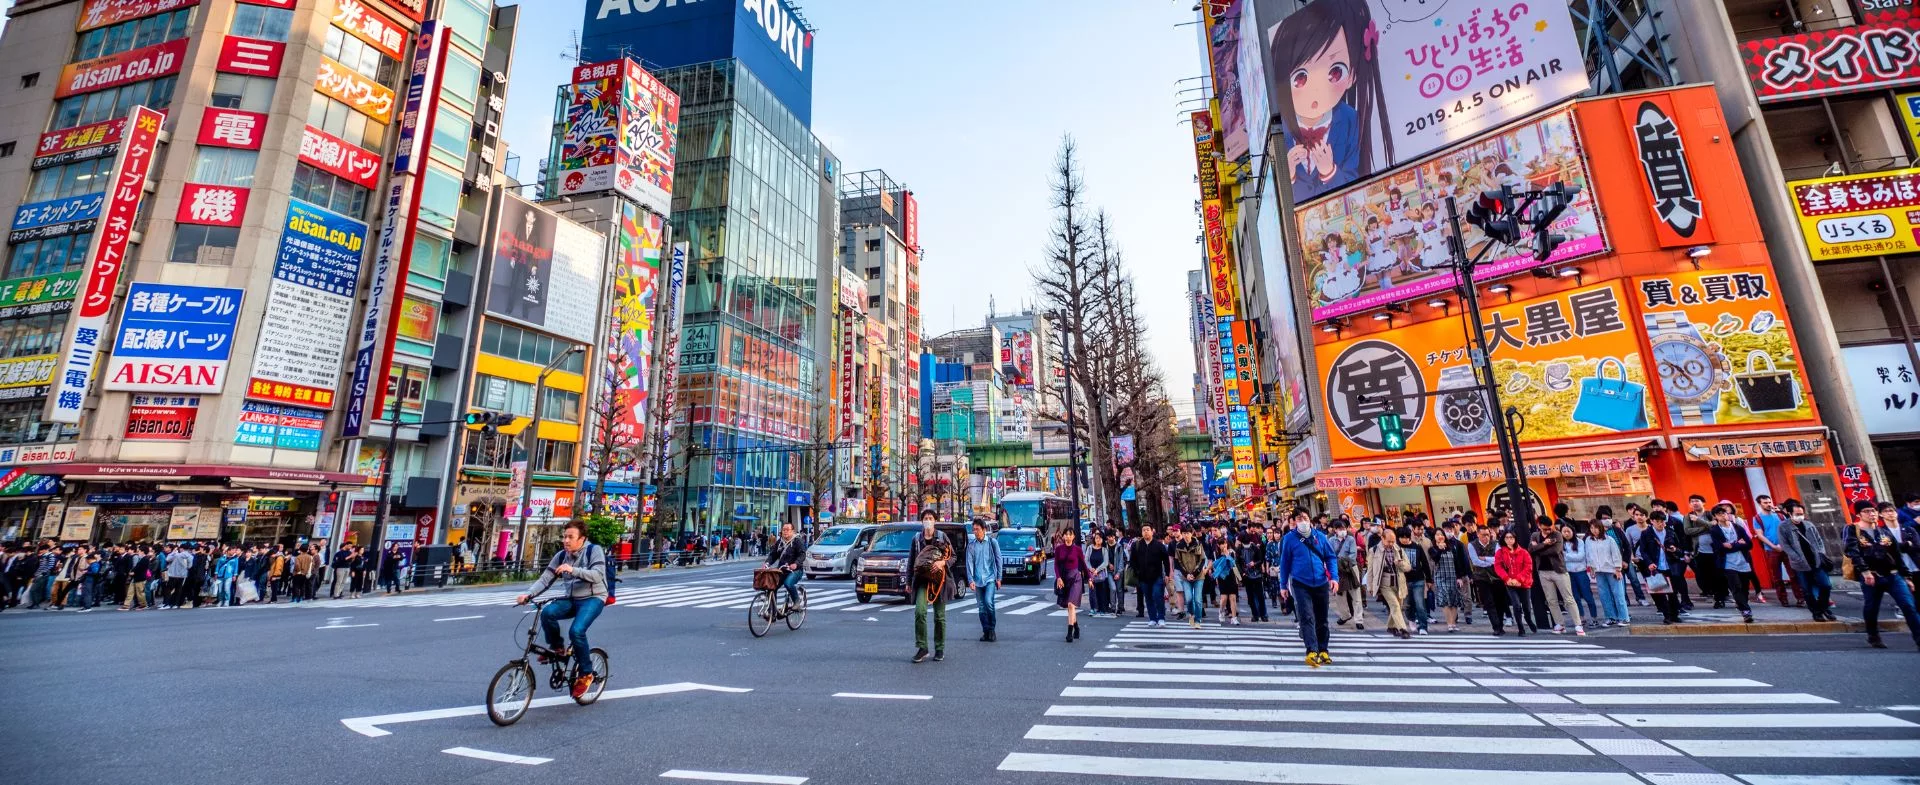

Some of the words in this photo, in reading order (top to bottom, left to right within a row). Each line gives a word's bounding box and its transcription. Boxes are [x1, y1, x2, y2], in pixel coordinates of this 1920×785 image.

[332, 0, 403, 54] 光通信
[743, 0, 803, 72] AOKI
[1405, 3, 1529, 68] ひとりぼっちの
[71, 52, 173, 90] aisan.co.jp
[579, 64, 619, 81] 免税店
[1764, 29, 1920, 89] メイド
[315, 63, 394, 115] ネットワーク
[1405, 91, 1484, 135] 2019.4.5
[1489, 75, 1520, 98] ON
[1526, 58, 1563, 85] AIR
[41, 134, 61, 151] 3F
[299, 130, 378, 179] 配線パーツ
[17, 210, 39, 227] 2F
[38, 195, 103, 226] ネットワーク
[289, 215, 362, 253] aisan.co.jp
[1823, 220, 1888, 239] りらくる
[363, 185, 402, 343] 各種ケーブル・ネットワーク機器
[1820, 241, 1907, 256] 秋葉原中央通り店
[672, 247, 684, 288] AKKY
[131, 287, 237, 320] 各種ケーブル
[1203, 296, 1214, 327] AKKY
[1481, 288, 1624, 357] 大黒屋
[121, 327, 229, 355] 配線パーツ
[57, 327, 98, 411] 愛三電機
[111, 362, 220, 388] AISAN
[1209, 339, 1225, 386] Tax-free
[1236, 343, 1251, 381] 吉野家
[1876, 364, 1913, 385] 喫茶
[347, 350, 373, 430] AISAN
[842, 362, 851, 398] カラオケ
[1214, 387, 1226, 416] Shop
[1231, 420, 1249, 429] DVD
[745, 447, 778, 478] AOKI
[1712, 438, 1822, 458] 1階にて高価買取中
[98, 466, 177, 475] http://www.aisan.co.jp
[1579, 456, 1638, 475] 無料査定
[1843, 467, 1862, 481] 4F
[131, 493, 153, 504] 1949
